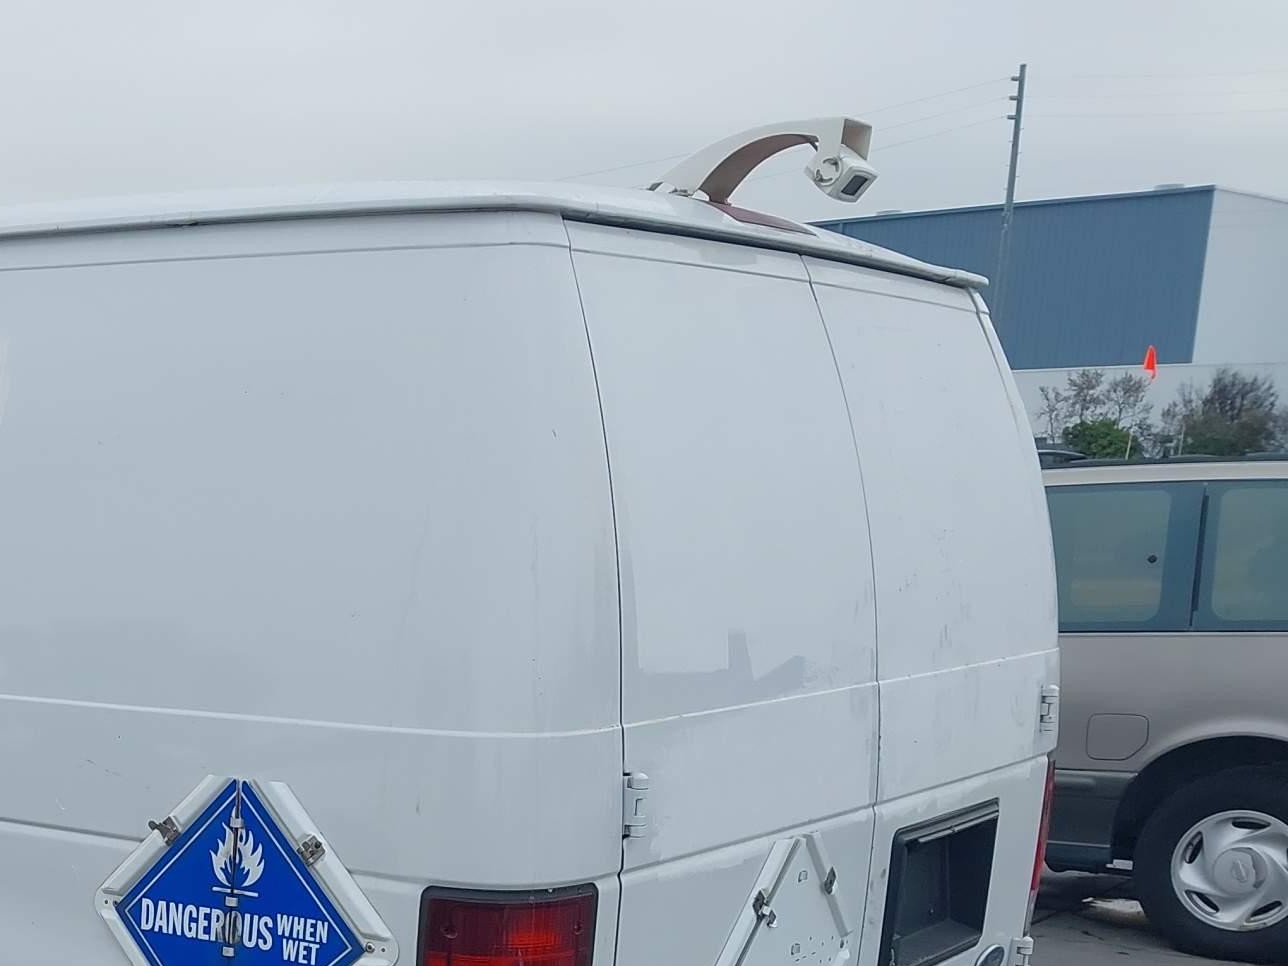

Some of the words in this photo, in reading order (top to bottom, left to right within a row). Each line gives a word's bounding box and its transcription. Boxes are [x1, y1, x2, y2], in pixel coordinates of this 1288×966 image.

[139, 897, 273, 951] DANGEROUS
[276, 913, 329, 943] WHEN
[282, 938, 320, 966] WET
